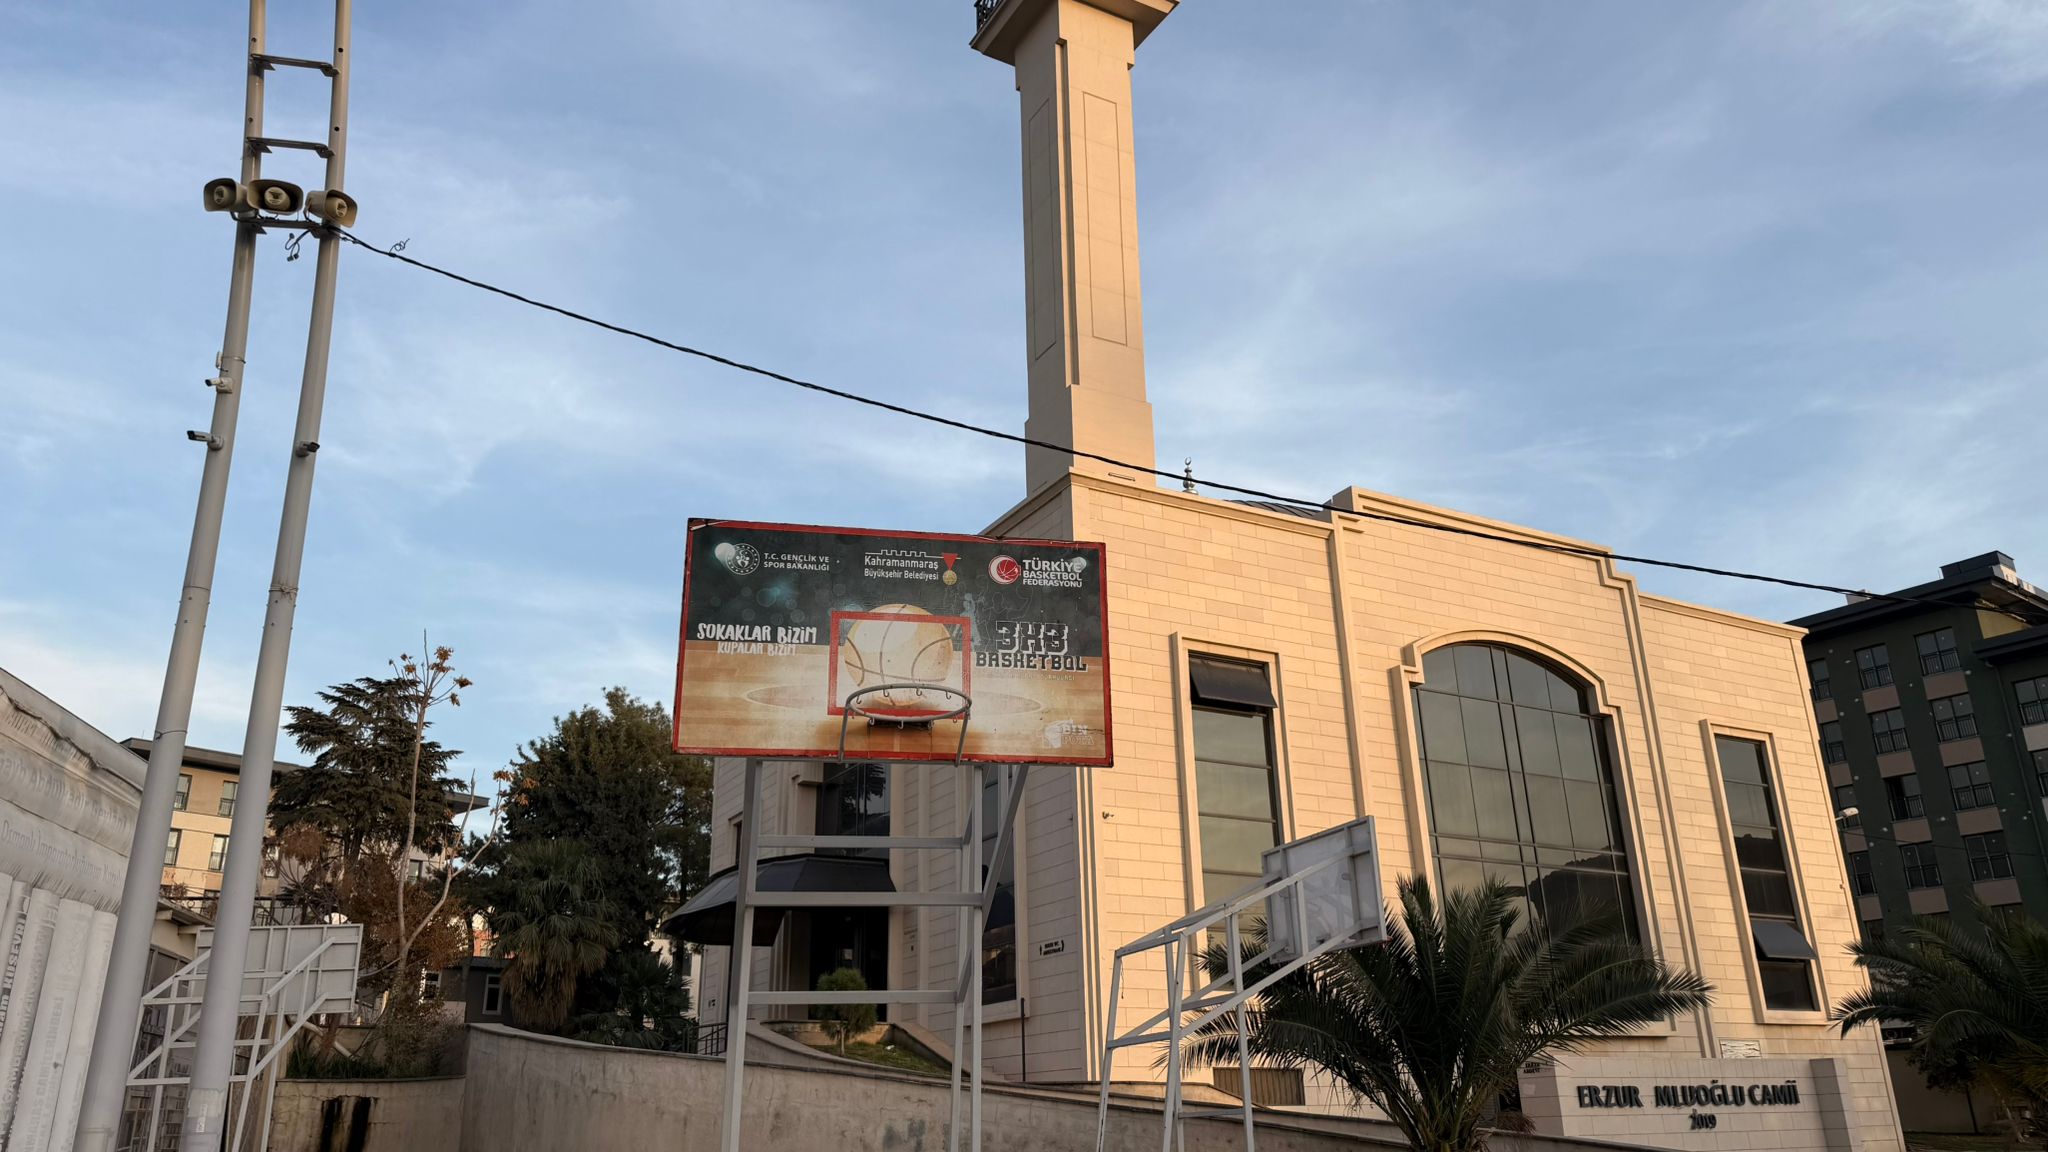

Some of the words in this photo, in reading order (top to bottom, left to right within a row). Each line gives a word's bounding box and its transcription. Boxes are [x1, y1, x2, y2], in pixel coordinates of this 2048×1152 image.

[764, 553, 779, 561] T.C.
[781, 553, 817, 563] GENÇLİK
[864, 555, 939, 571] Kahramanmaraş
[1022, 557, 1082, 573] TÜRKİYE
[764, 561, 785, 569] SPOR
[787, 562, 830, 571] BAKANLIĞI
[864, 568, 902, 579] Büyükşehir
[904, 570, 939, 581] Belediyesi
[1023, 571, 1083, 581] BASKETBOL
[1023, 579, 1083, 588] FEDERASYONU
[697, 622, 771, 641] SOKAKLAR
[717, 642, 764, 655] KUPALAR
[975, 652, 1089, 673] BASKETBOL
[1576, 1085, 1644, 1108] ERZUR
[1654, 1080, 1746, 1108] MLUOĞLU
[1747, 1080, 1801, 1106] CAMİİ
[1689, 1109, 1717, 1130] 2019
